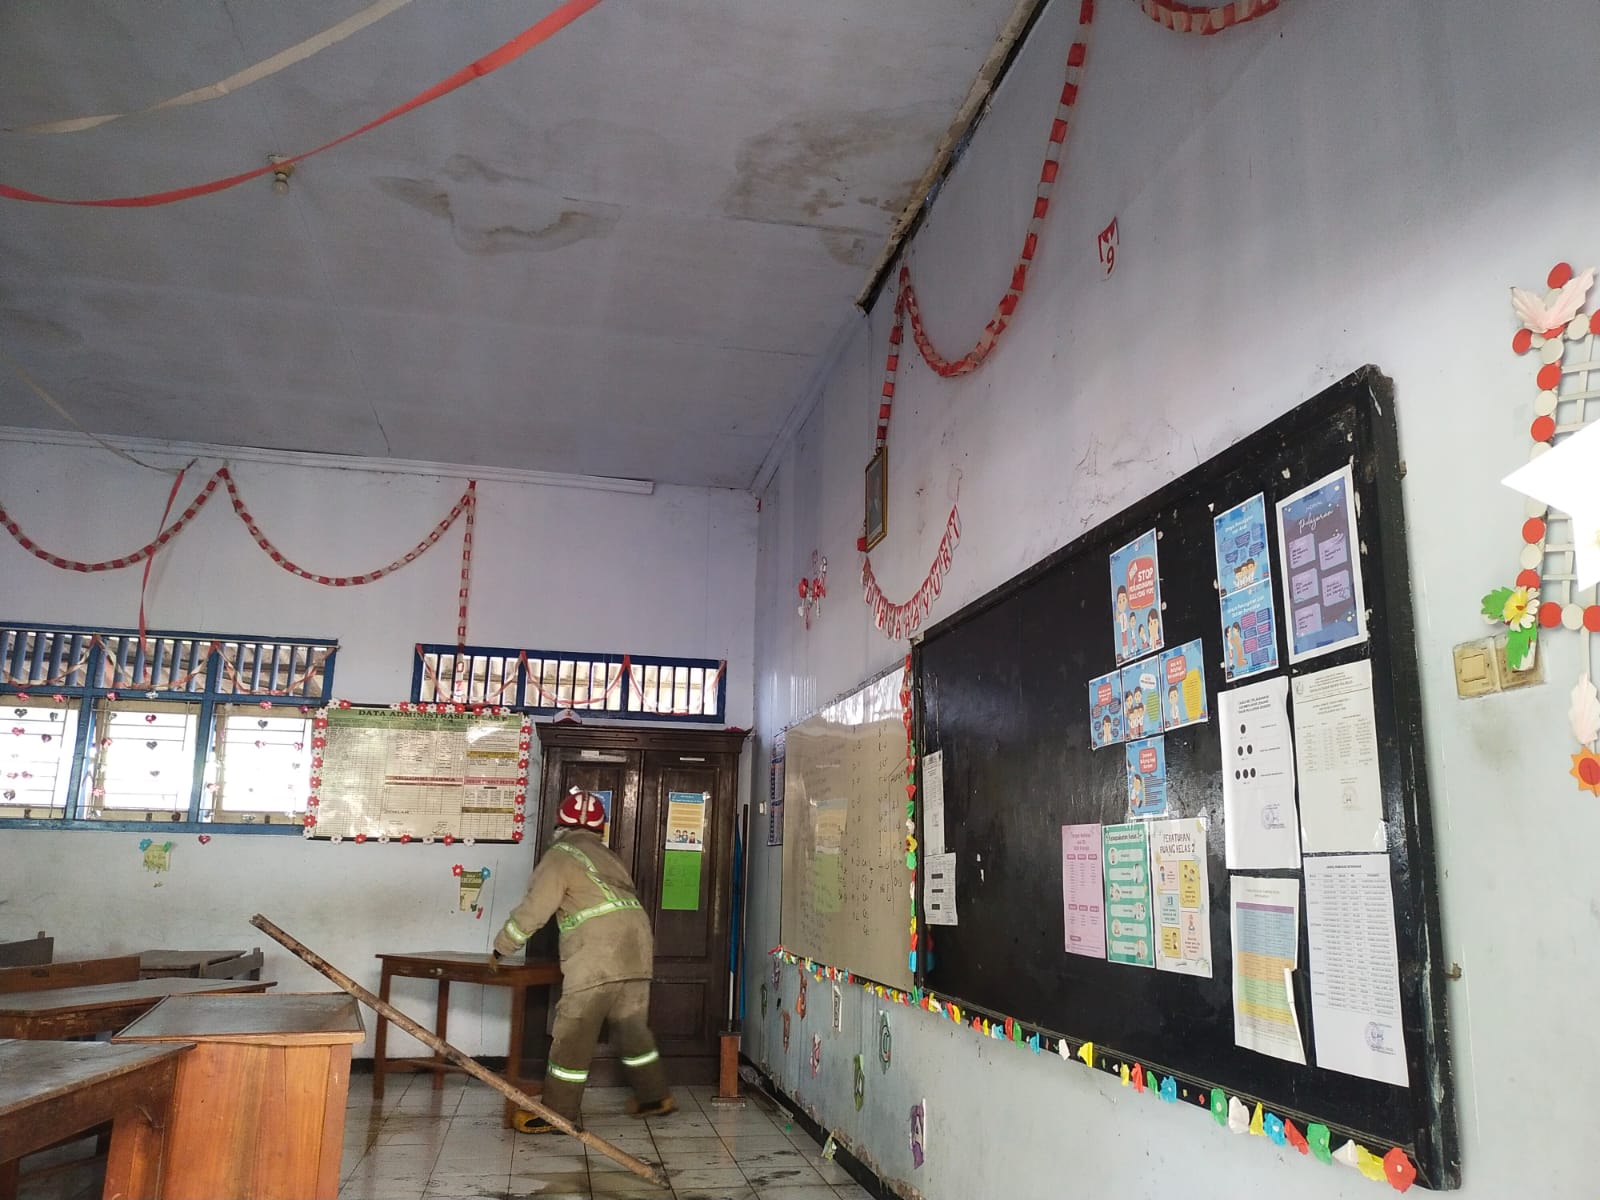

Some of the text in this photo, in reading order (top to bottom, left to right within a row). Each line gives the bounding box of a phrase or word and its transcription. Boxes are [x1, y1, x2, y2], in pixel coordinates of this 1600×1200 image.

[1137, 567, 1154, 582] STOP
[358, 709, 386, 717] DATA
[1163, 832, 1191, 843] PERATURAN
